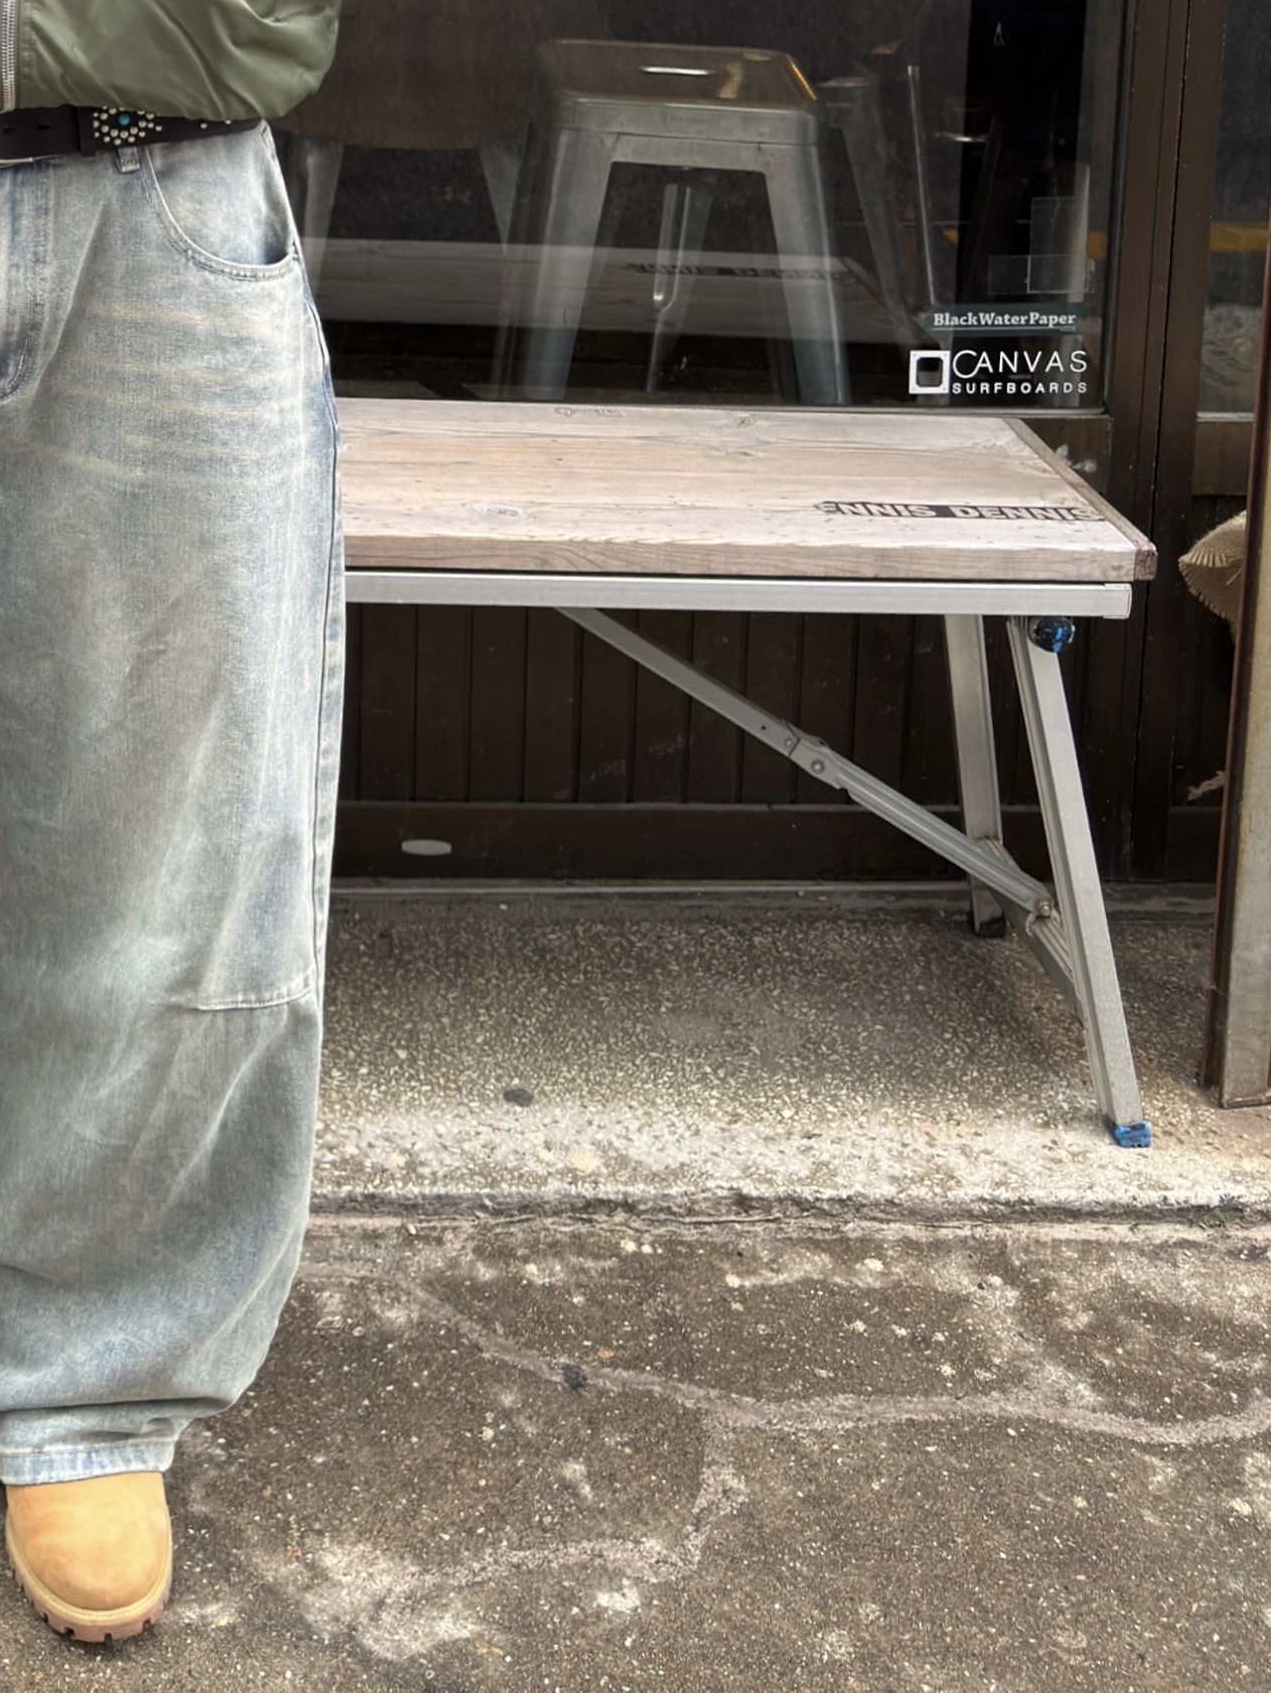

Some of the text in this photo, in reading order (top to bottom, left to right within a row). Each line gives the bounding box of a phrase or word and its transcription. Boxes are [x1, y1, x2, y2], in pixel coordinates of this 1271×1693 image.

[952, 349, 1088, 379] CANVAS
[951, 382, 1087, 394] SURFBOARDS
[948, 506, 1102, 521] DENNIS
